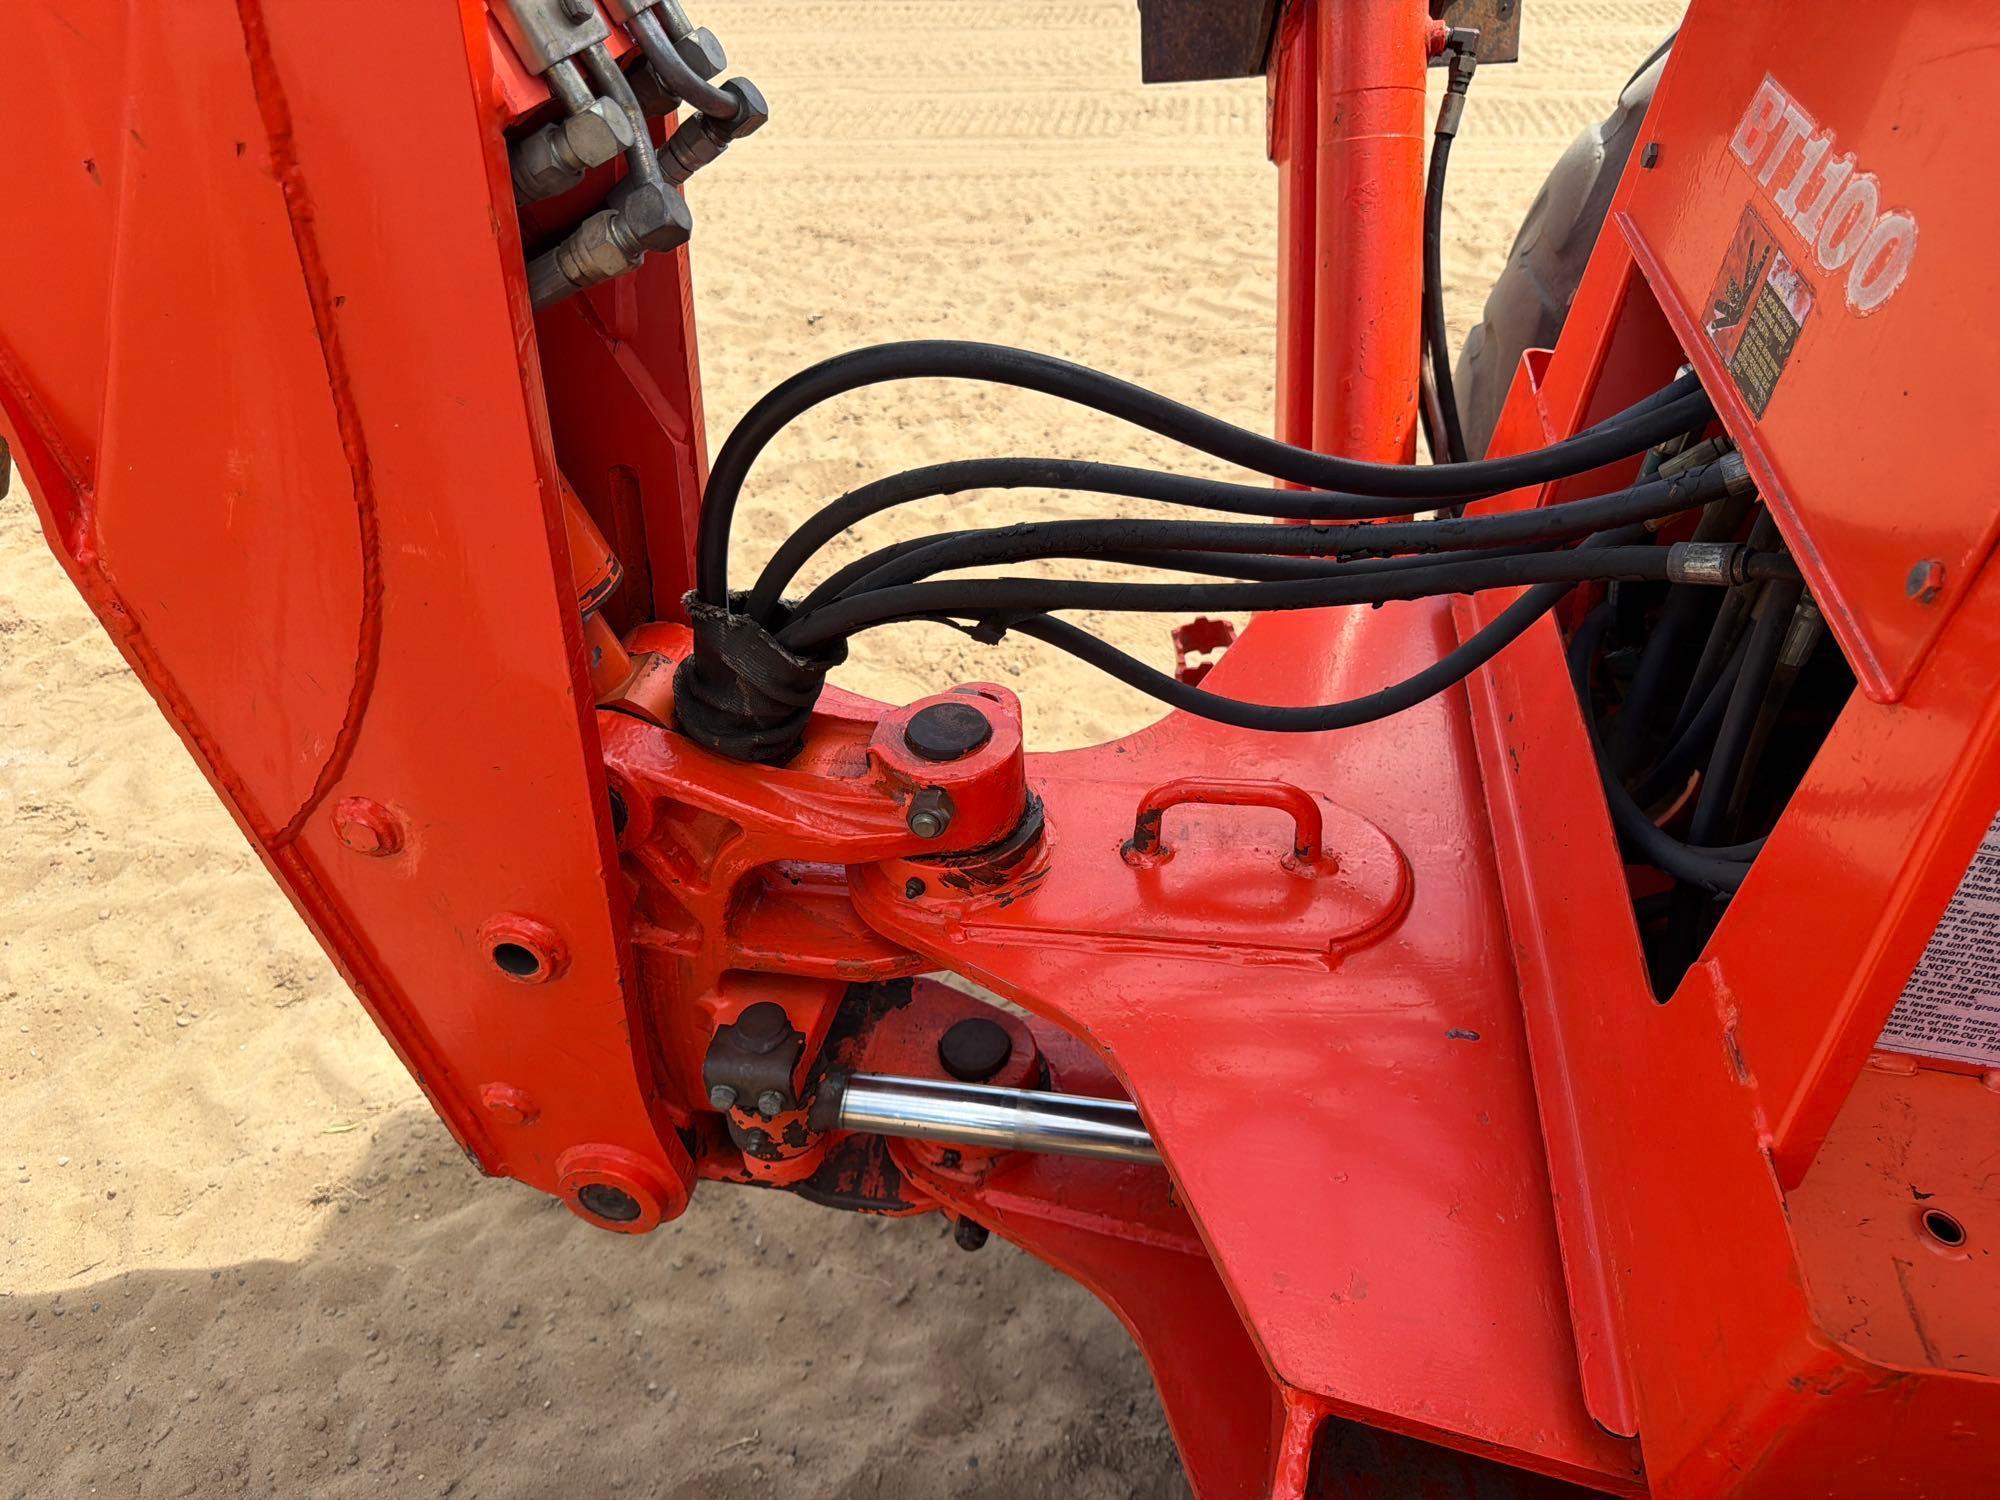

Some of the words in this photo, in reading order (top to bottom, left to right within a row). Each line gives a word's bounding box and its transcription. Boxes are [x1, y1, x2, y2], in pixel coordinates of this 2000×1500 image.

[1730, 79, 1916, 310] BT1100
[1980, 842, 2000, 852] loc
[1972, 874, 1991, 883] the
[1971, 911, 2000, 921] pads
[1951, 924, 1979, 935] from
[1960, 918, 1998, 930] slowly
[1932, 931, 1949, 939] oe
[1953, 933, 1967, 943] by
[1925, 947, 1966, 958] upport
[1946, 942, 1973, 951] until
[1976, 946, 1994, 955] the
[1924, 954, 1969, 967] forward
[1971, 962, 1998, 972] from
[1926, 962, 1953, 972] NOT
[1955, 966, 1971, 976] TO
[1973, 970, 2000, 981] DAM
[1933, 971, 1957, 982] THE
[1922, 979, 1948, 988] onto
[1951, 982, 1969, 991] the
[1917, 985, 1935, 994] the
[1937, 990, 1976, 1001] engine.
[1909, 1000, 1939, 1011] lever.
[1926, 996, 1951, 1005] onto
[1954, 999, 1973, 1008] the
[1911, 1007, 1962, 1022] hydraulic
[1965, 1017, 2000, 1028] hoses.
[1887, 1021, 1912, 1029] ever
[1914, 1024, 1925, 1032] to
[1928, 1026, 1986, 1040] WITH-OUT
[1942, 1021, 1960, 1030] the
[1905, 1031, 1934, 1041] valve
[1936, 1036, 1964, 1046] lever
